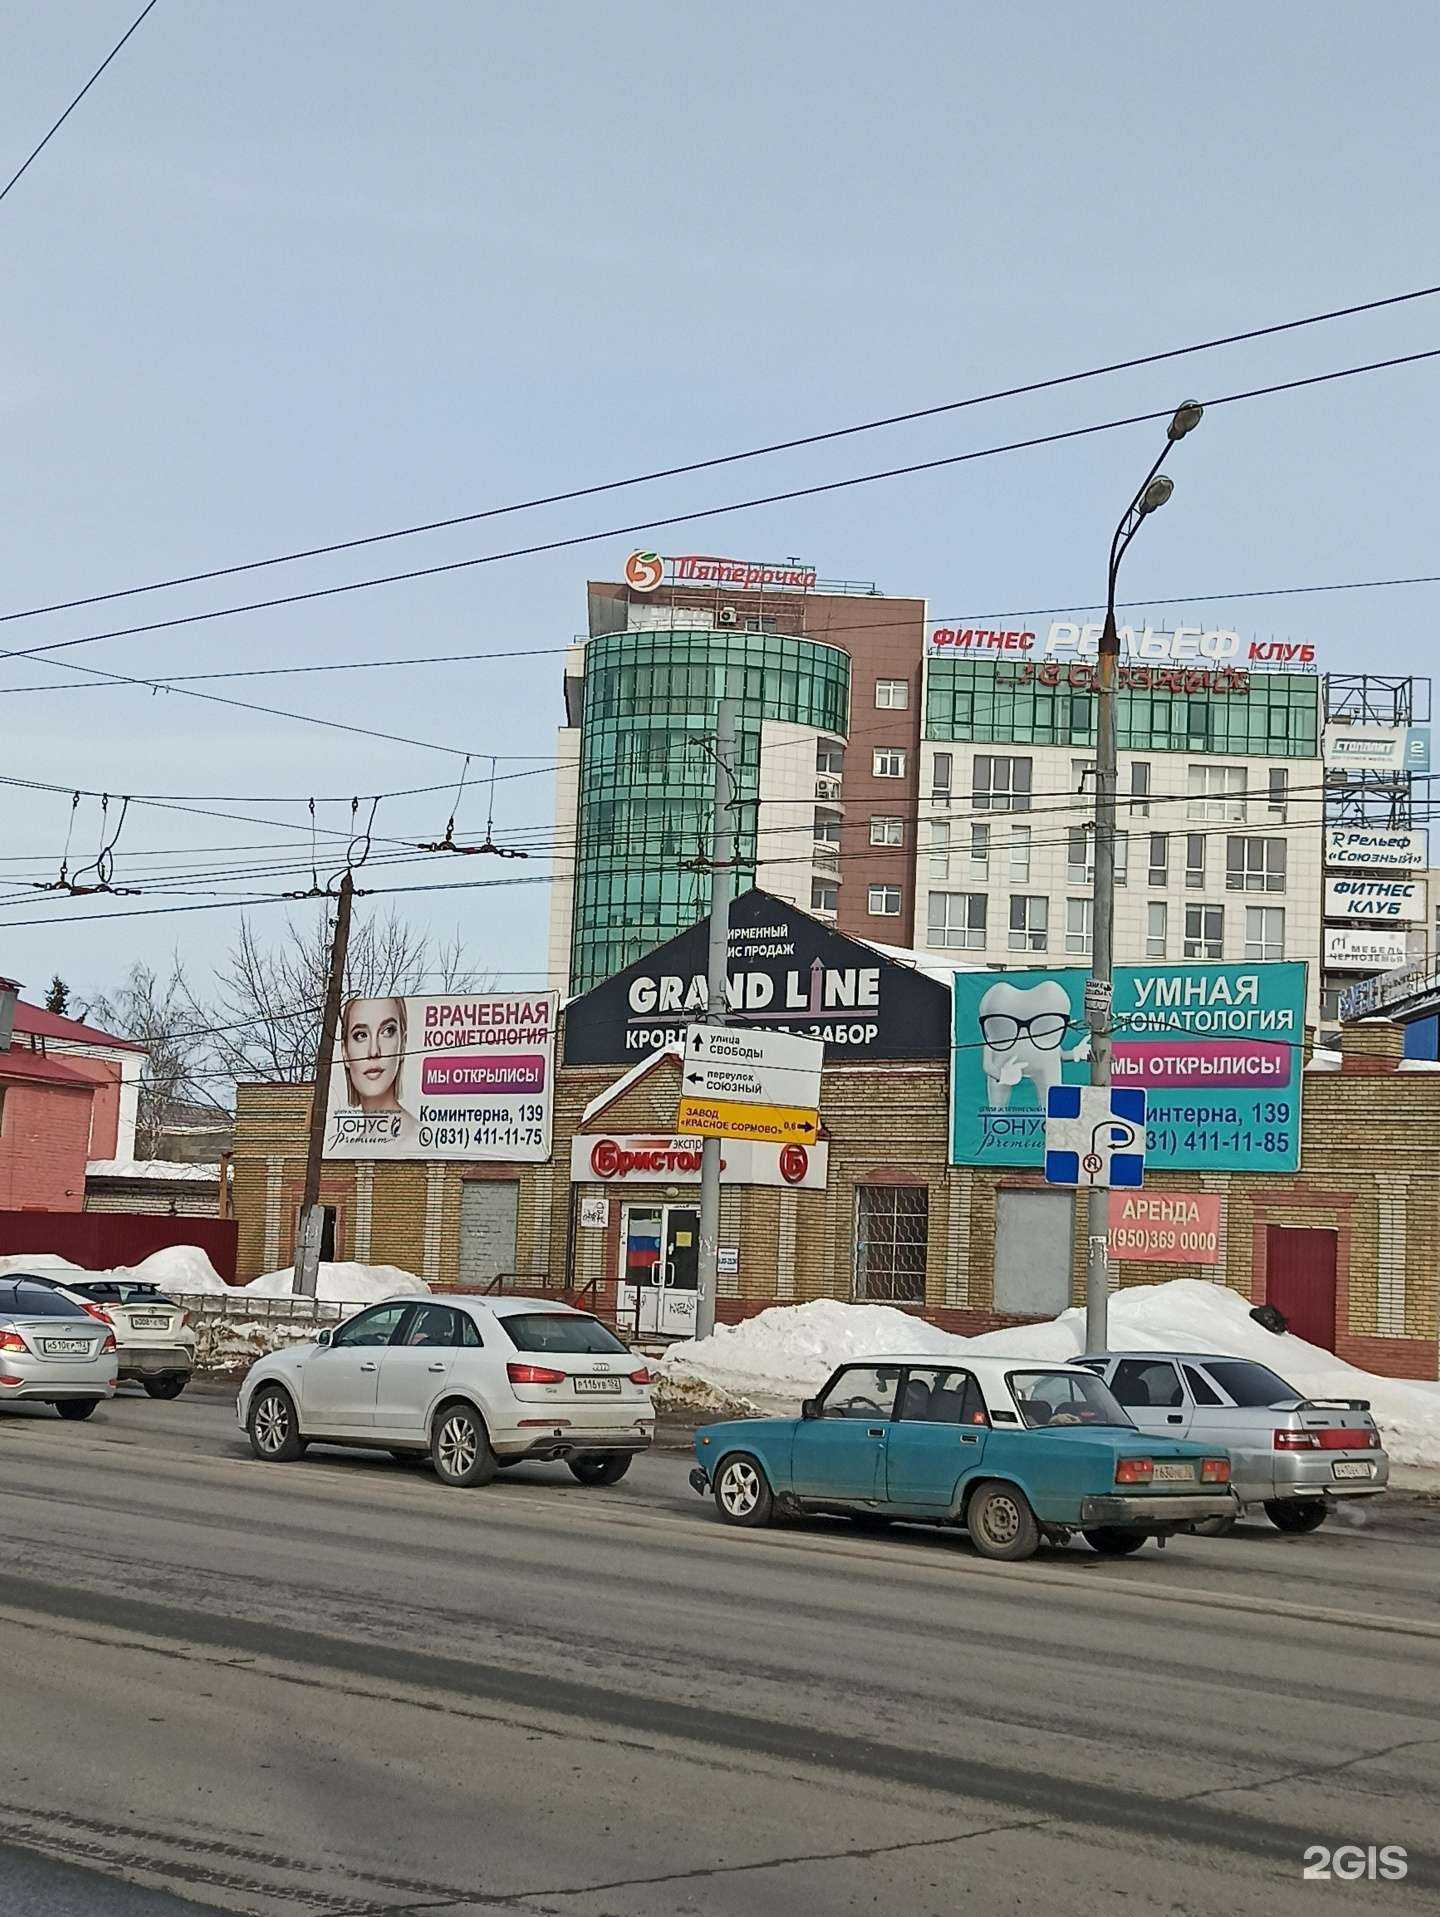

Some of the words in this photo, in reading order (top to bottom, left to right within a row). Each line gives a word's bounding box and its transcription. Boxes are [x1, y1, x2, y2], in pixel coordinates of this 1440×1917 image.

[672, 554, 816, 589] Пятерочка
[932, 627, 1035, 650] ФИТНЕС
[1044, 622, 1241, 661] РЕЛЬЕФ
[1248, 641, 1316, 662] КЛУБ
[1347, 834, 1411, 849] Рельеф
[1328, 850, 1422, 864] «Союзный»
[1333, 882, 1416, 897] ФИТНЕС
[1347, 900, 1402, 915] КЛУБ
[727, 924, 788, 940] ИРМЕННЫЙ
[744, 943, 795, 958] ПРОДАЖ
[1351, 945, 1403, 955] МЕБЕЛЬ
[628, 973, 774, 1014] GRAND
[1133, 976, 1259, 1008] УМНАЯ
[425, 1001, 549, 1027] ВРАЧЕБНАЯ
[424, 1028, 548, 1047] КОСМЕТОЛОГИЯ
[710, 1034, 740, 1045] улица
[710, 1045, 763, 1059] СВОБОДЫ
[1111, 1058, 1144, 1075] МЫ
[1150, 1056, 1280, 1075] ОТКРЫЛИСЬ!
[427, 1069, 449, 1084] МЫ
[453, 1067, 538, 1083] ОТКРЫЛИСЬ!
[707, 1070, 754, 1082] переулок
[706, 1081, 762, 1094] СОЮЗНЫЙ
[419, 1105, 513, 1125] Коминтерна,
[518, 1104, 543, 1121] 139
[686, 1107, 719, 1120] ЗАВОД
[1252, 1103, 1290, 1124] 139
[681, 1118, 729, 1130] «КРАСНОЕ
[731, 1122, 783, 1135] СОРМОВО»
[435, 1127, 469, 1149] (831)
[474, 1127, 542, 1145] 411-11-75
[1184, 1131, 1289, 1152] 411-11-85
[1122, 1199, 1200, 1226] АРЕНДА
[1180, 1232, 1217, 1250] 0000
